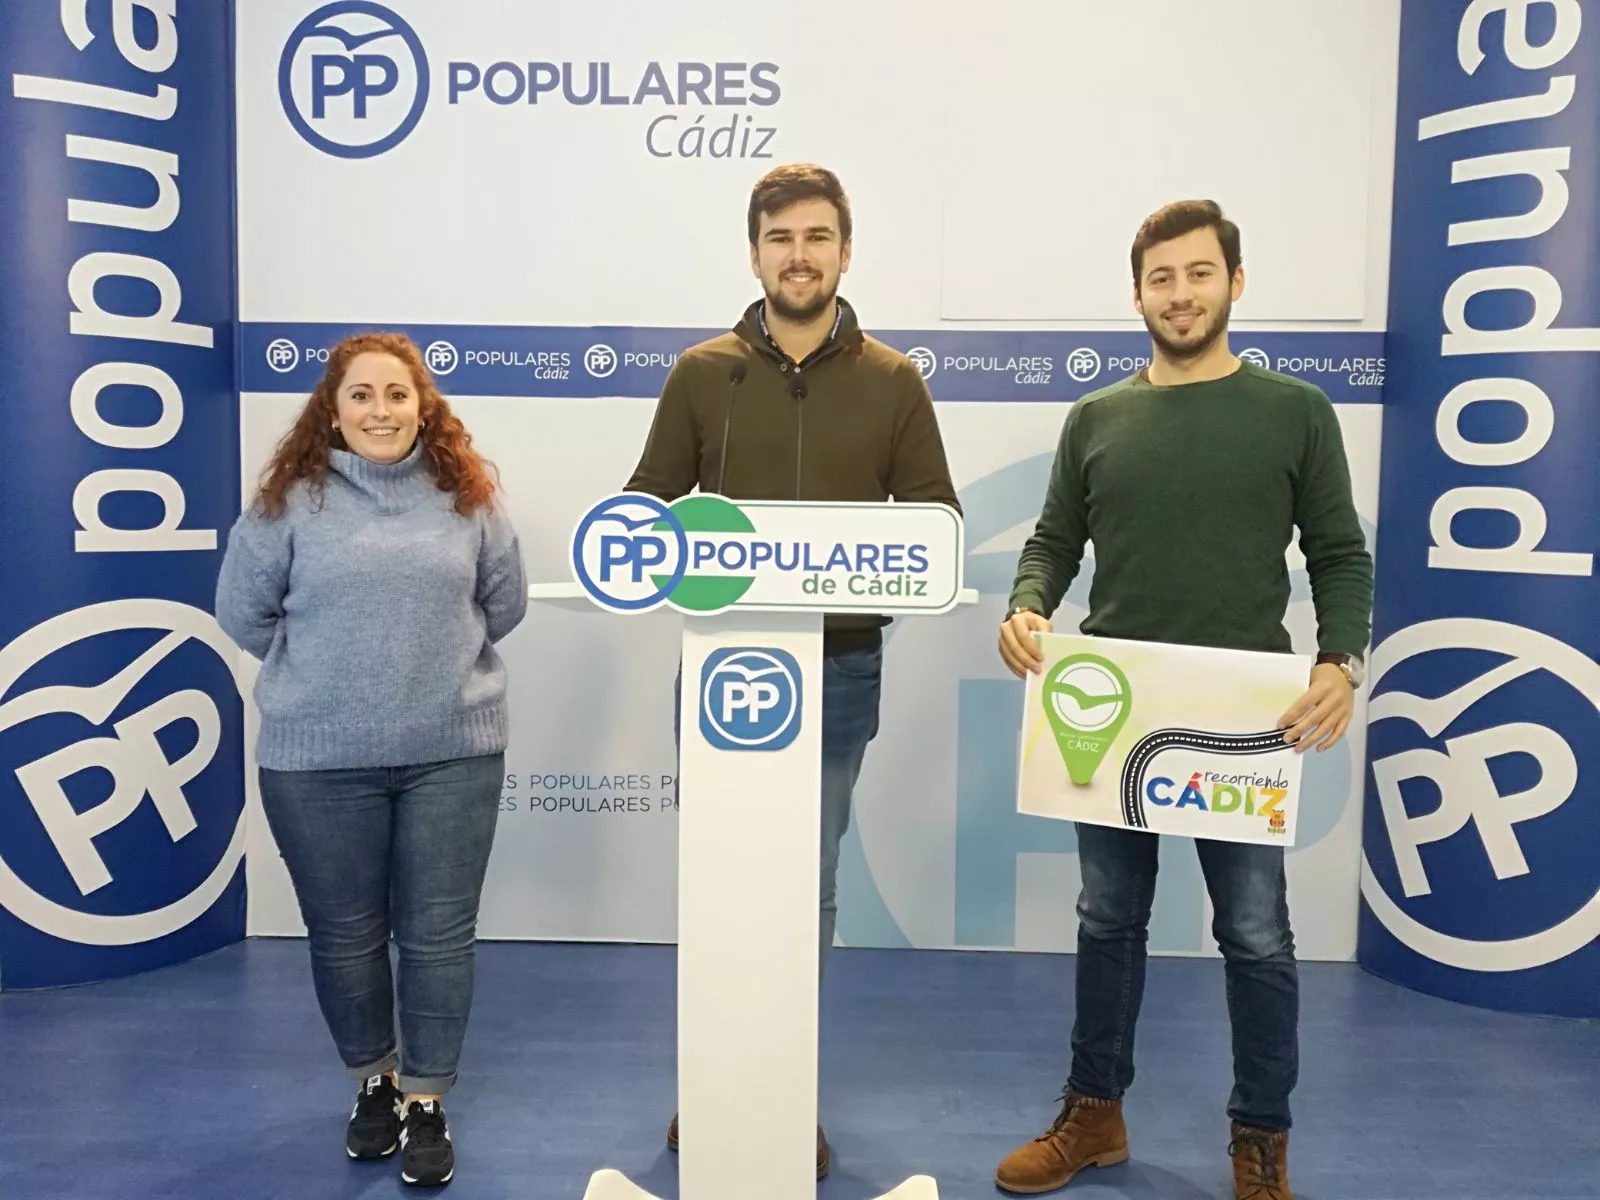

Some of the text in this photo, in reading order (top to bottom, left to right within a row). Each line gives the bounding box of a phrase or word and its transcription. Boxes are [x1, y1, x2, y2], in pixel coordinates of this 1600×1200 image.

[311, 53, 399, 119] PP
[448, 61, 781, 106] POPULARES
[645, 114, 778, 158] Cádiz
[273, 349, 293, 365] PP
[432, 351, 571, 367] PP POPULARES
[591, 355, 611, 370] PP
[944, 357, 1053, 371] POPULARES
[1277, 357, 1386, 372] POPULARES
[534, 366, 570, 380] Cádiz
[1073, 358, 1094, 374] PP
[1014, 371, 1051, 384] Cádiz
[1348, 372, 1385, 386] Cádiz
[600, 535, 929, 583] PP POPULARES
[801, 571, 928, 597] de Cádiz
[722, 681, 780, 724] PP
[530, 774, 650, 790] POPULARES
[1204, 768, 1289, 789] recorriendo
[14, 688, 222, 896] PP
[1146, 771, 1288, 817] CÁDIZ
[530, 796, 650, 812] POPULARES
[1373, 722, 1578, 898] PP
